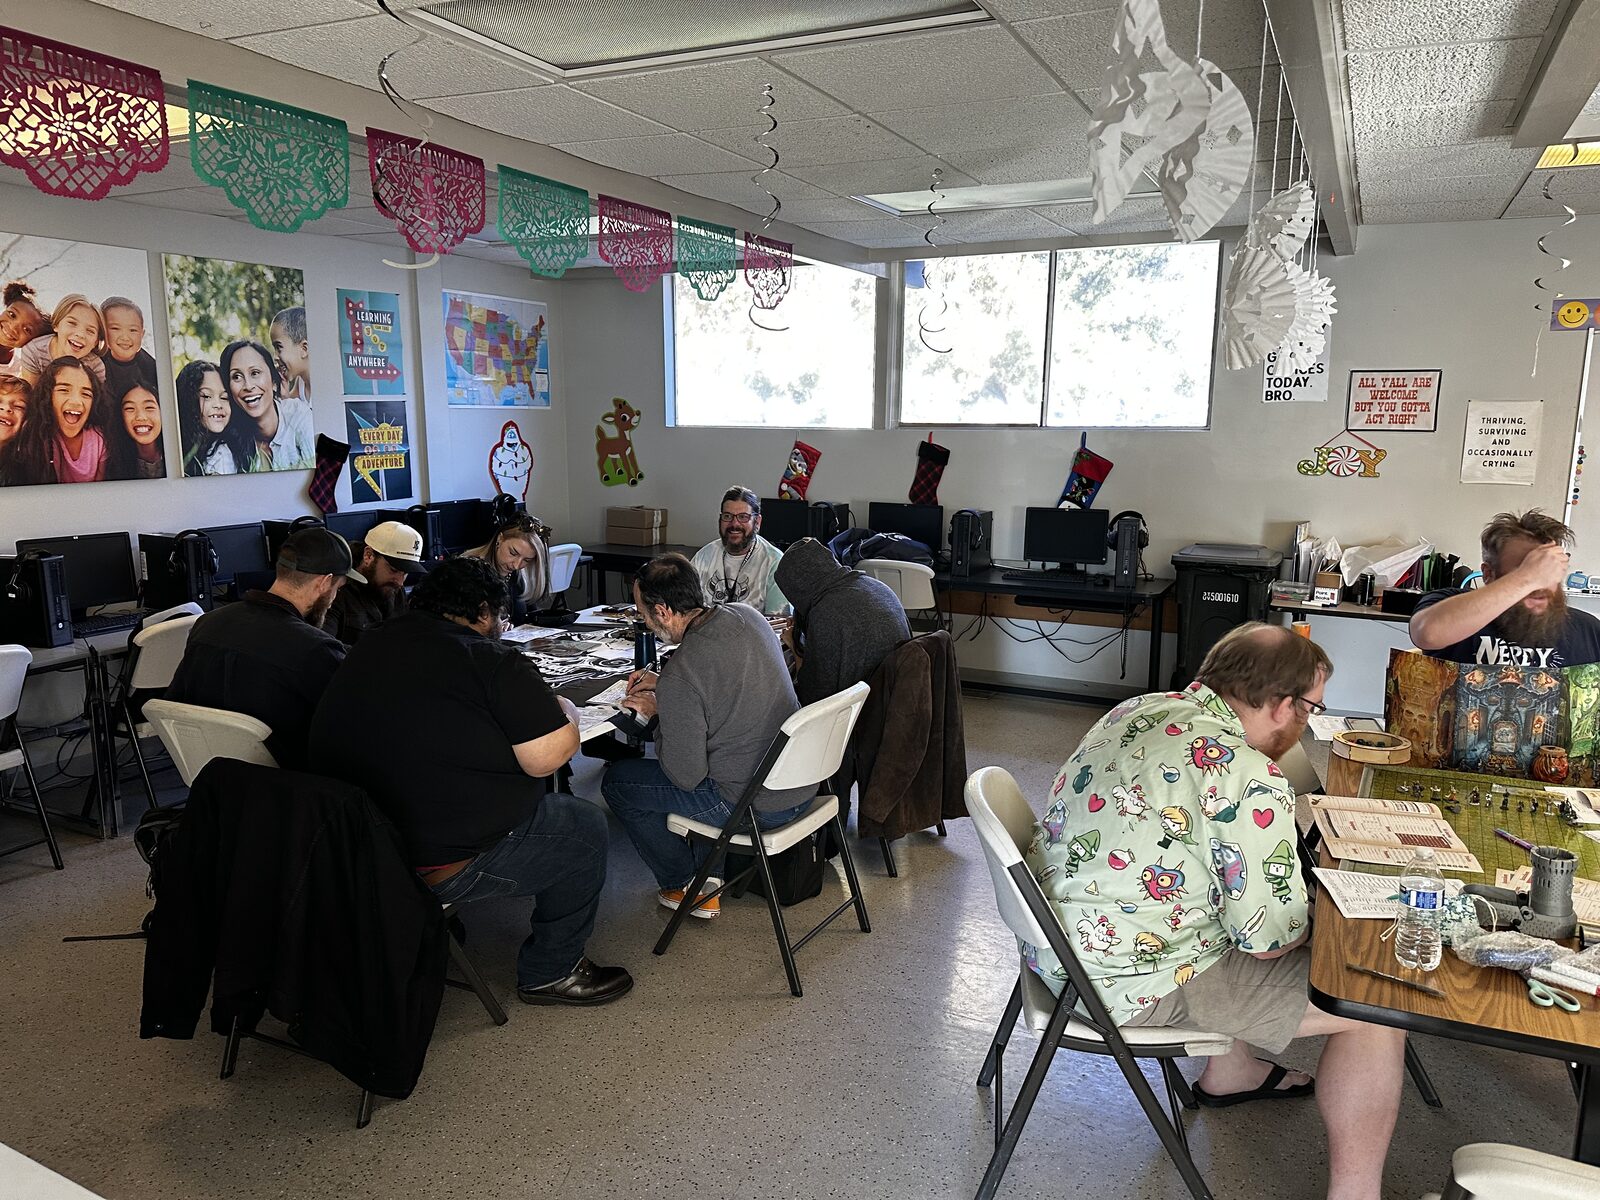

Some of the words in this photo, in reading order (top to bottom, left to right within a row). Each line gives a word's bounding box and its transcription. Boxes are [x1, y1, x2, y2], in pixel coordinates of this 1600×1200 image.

[356, 311, 392, 324] LEARNING
[348, 355, 386, 367] ANYWHERE
[1266, 376, 1313, 388] TODAY.
[1358, 377, 1376, 388] ALL
[1381, 377, 1408, 388] Y'ALL
[1412, 377, 1432, 388] ARE
[1265, 390, 1296, 401] BRO.
[1370, 389, 1418, 400] WELCOME
[1354, 401, 1374, 412] BUT
[1378, 401, 1397, 412] YOU
[1401, 402, 1431, 412] GOTTA
[1365, 413, 1385, 425] ACT
[1388, 413, 1418, 425] RIGHT
[363, 430, 385, 441] EVERY
[387, 430, 400, 441] DAY
[1478, 428, 1527, 436] SURVIVING
[1491, 438, 1511, 446] AND
[1467, 448, 1534, 457] OCCASIONALLY
[362, 457, 403, 469] ADVENTURE
[1297, 446, 1387, 477] JOY
[1482, 460, 1516, 468] CRYING
